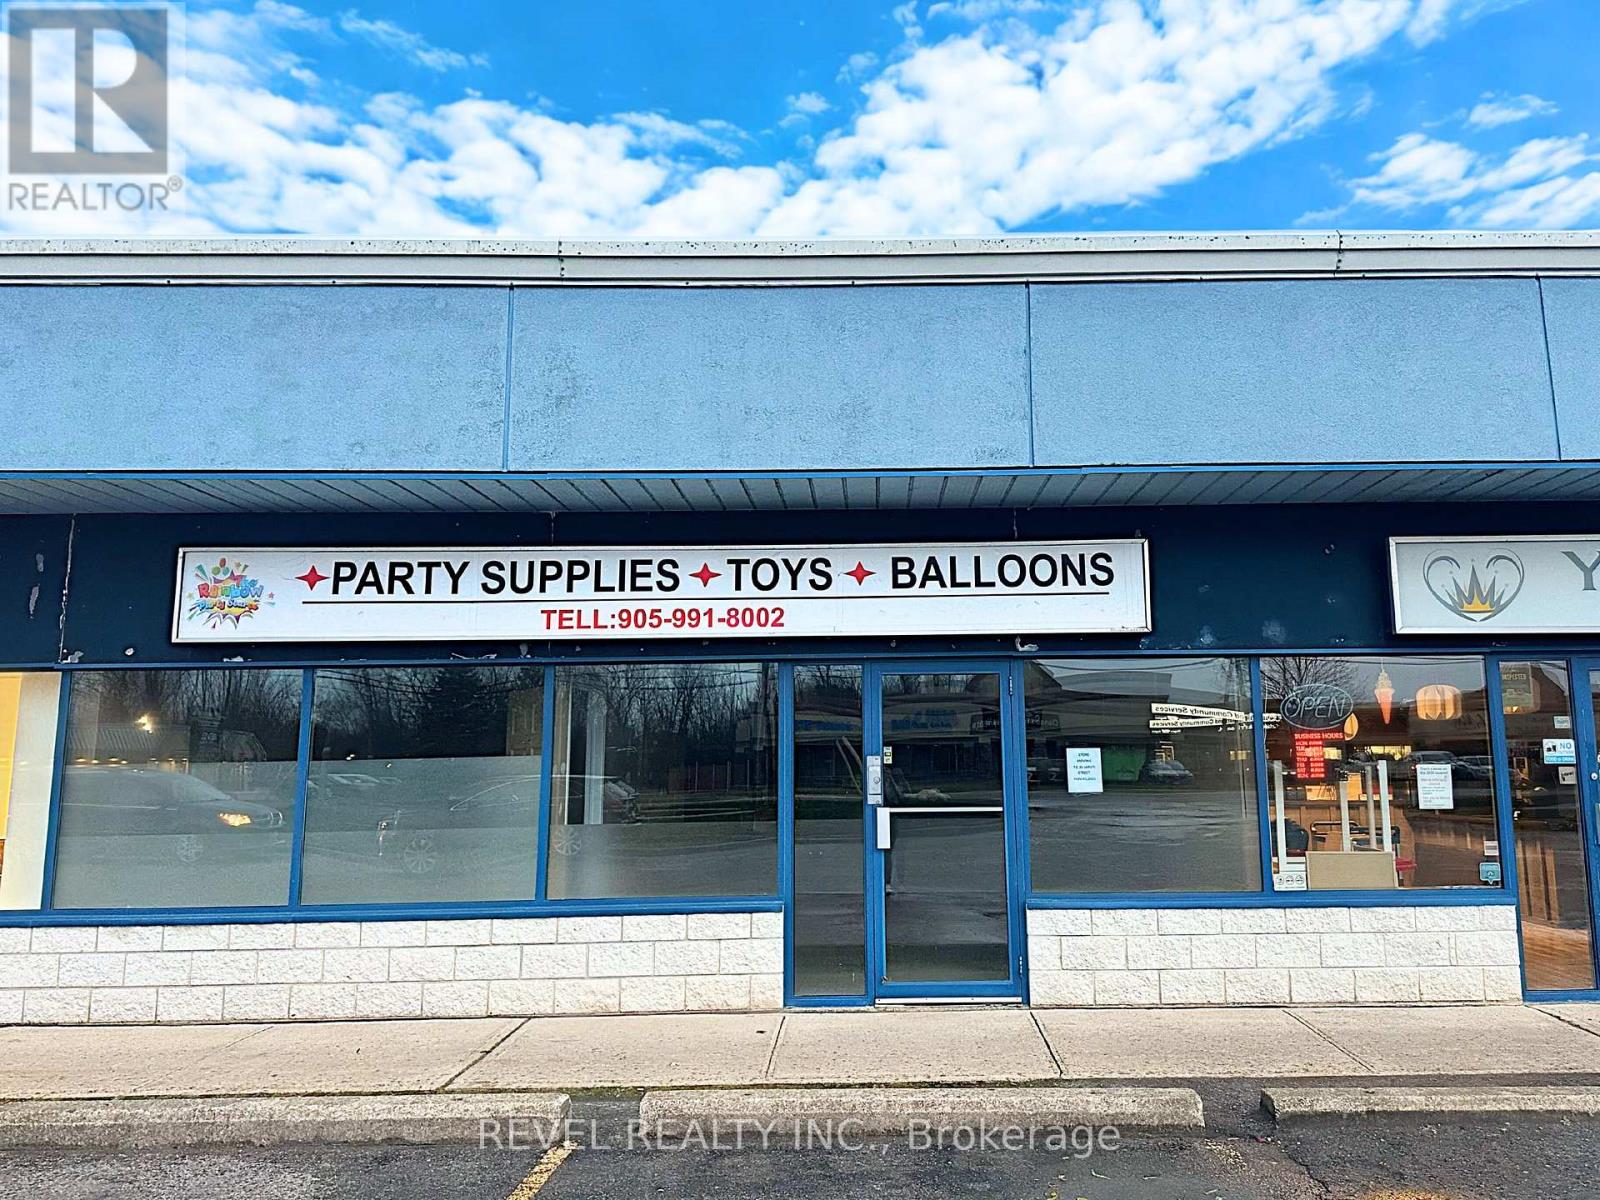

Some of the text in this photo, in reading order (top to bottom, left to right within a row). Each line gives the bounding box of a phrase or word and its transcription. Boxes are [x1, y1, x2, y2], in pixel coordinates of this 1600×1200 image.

[331, 552, 1115, 595] PARTY SUPPLIES TOYS BALLOONS
[540, 606, 785, 630] TELL:905-991-8002
[1284, 695, 1347, 718] OPEN
